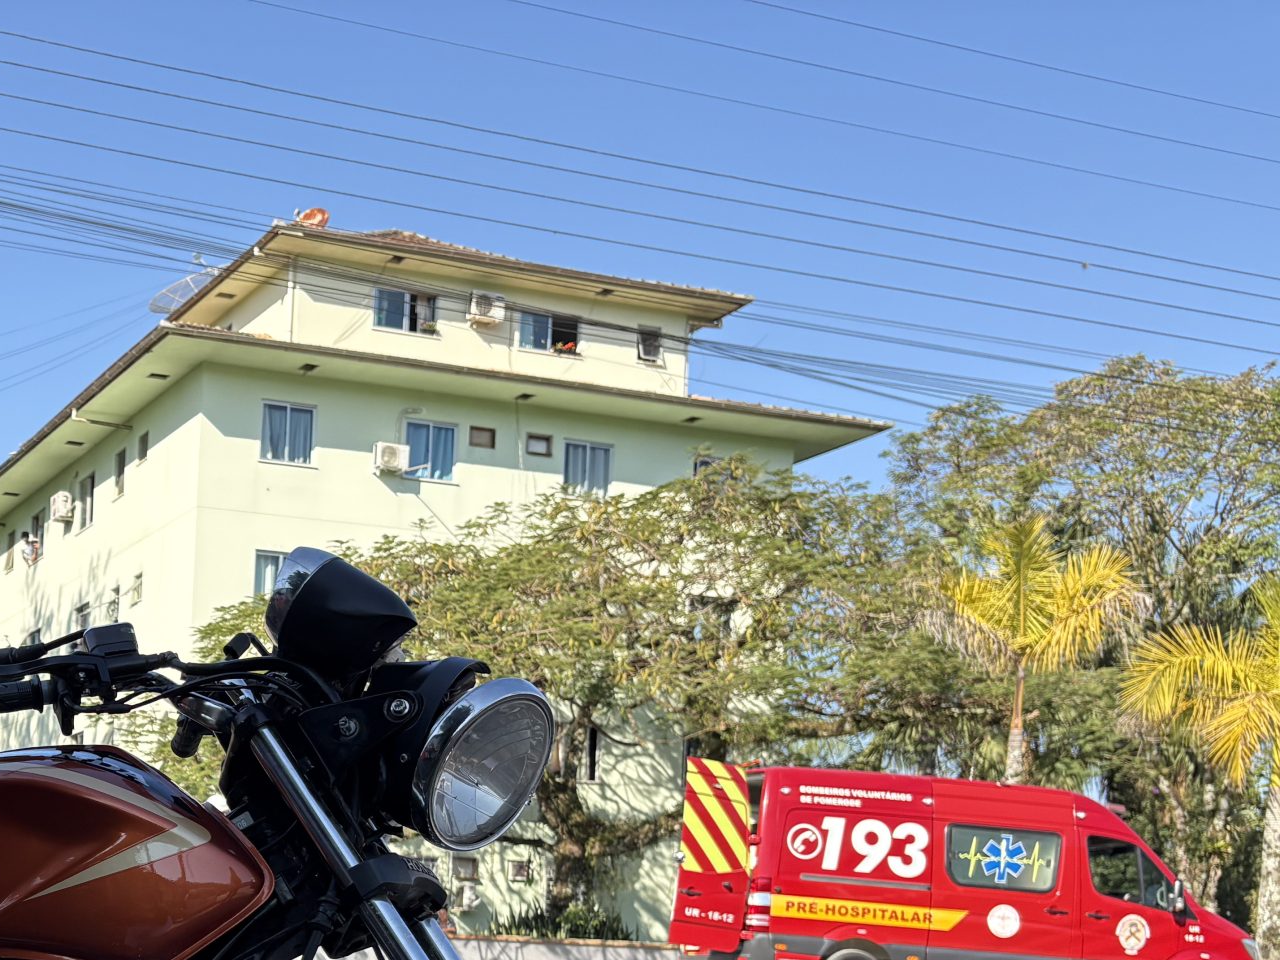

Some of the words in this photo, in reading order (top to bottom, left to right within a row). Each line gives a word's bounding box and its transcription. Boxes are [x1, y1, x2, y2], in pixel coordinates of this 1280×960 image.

[799, 785, 851, 797] BOMBEIROS
[851, 788, 913, 803] VOLUNTÁRIOS
[799, 795, 812, 804] DE
[821, 816, 929, 879] 193
[684, 907, 701, 918] UR
[708, 910, 735, 923] 18-12
[785, 900, 934, 925] PRÉ-HOSPITALAR
